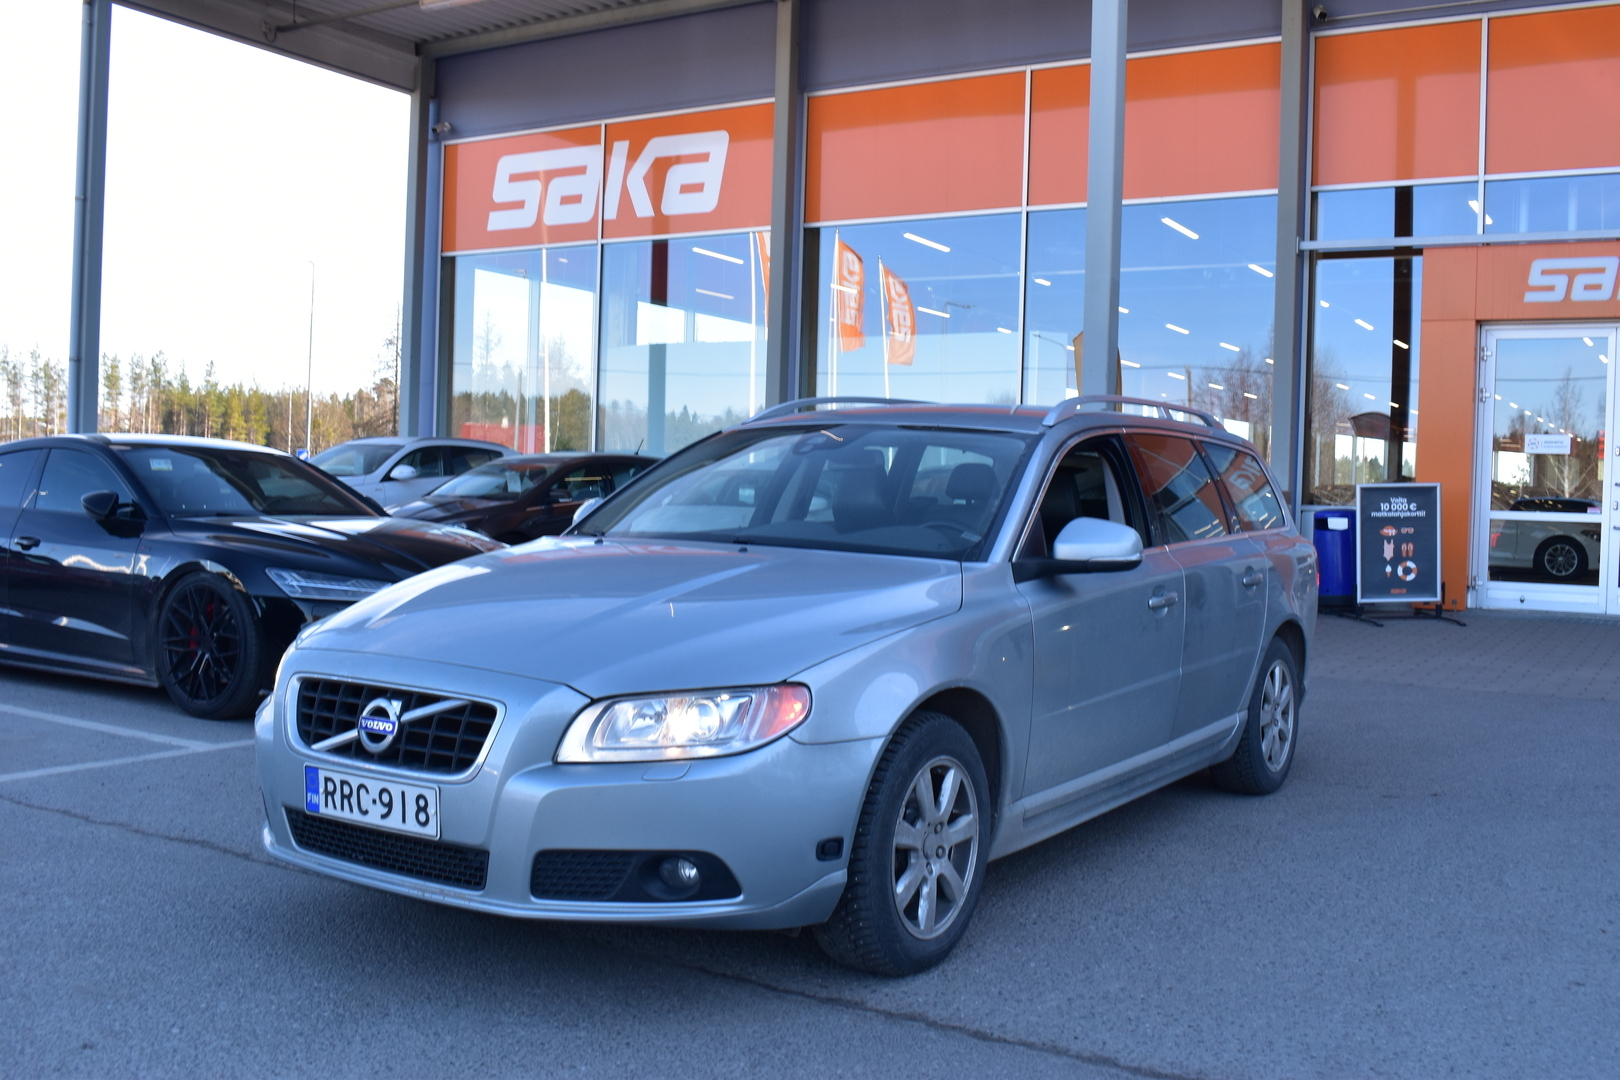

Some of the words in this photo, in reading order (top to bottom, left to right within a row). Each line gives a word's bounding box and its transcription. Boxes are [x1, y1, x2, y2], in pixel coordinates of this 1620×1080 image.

[1523, 256, 1620, 303] sa
[1380, 503, 1390, 511] 10
[1391, 503, 1408, 511] 000
[1409, 503, 1417, 511] €
[361, 719, 393, 732] VOLVO
[307, 792, 319, 805] FIN
[323, 776, 430, 827] RRC-918
